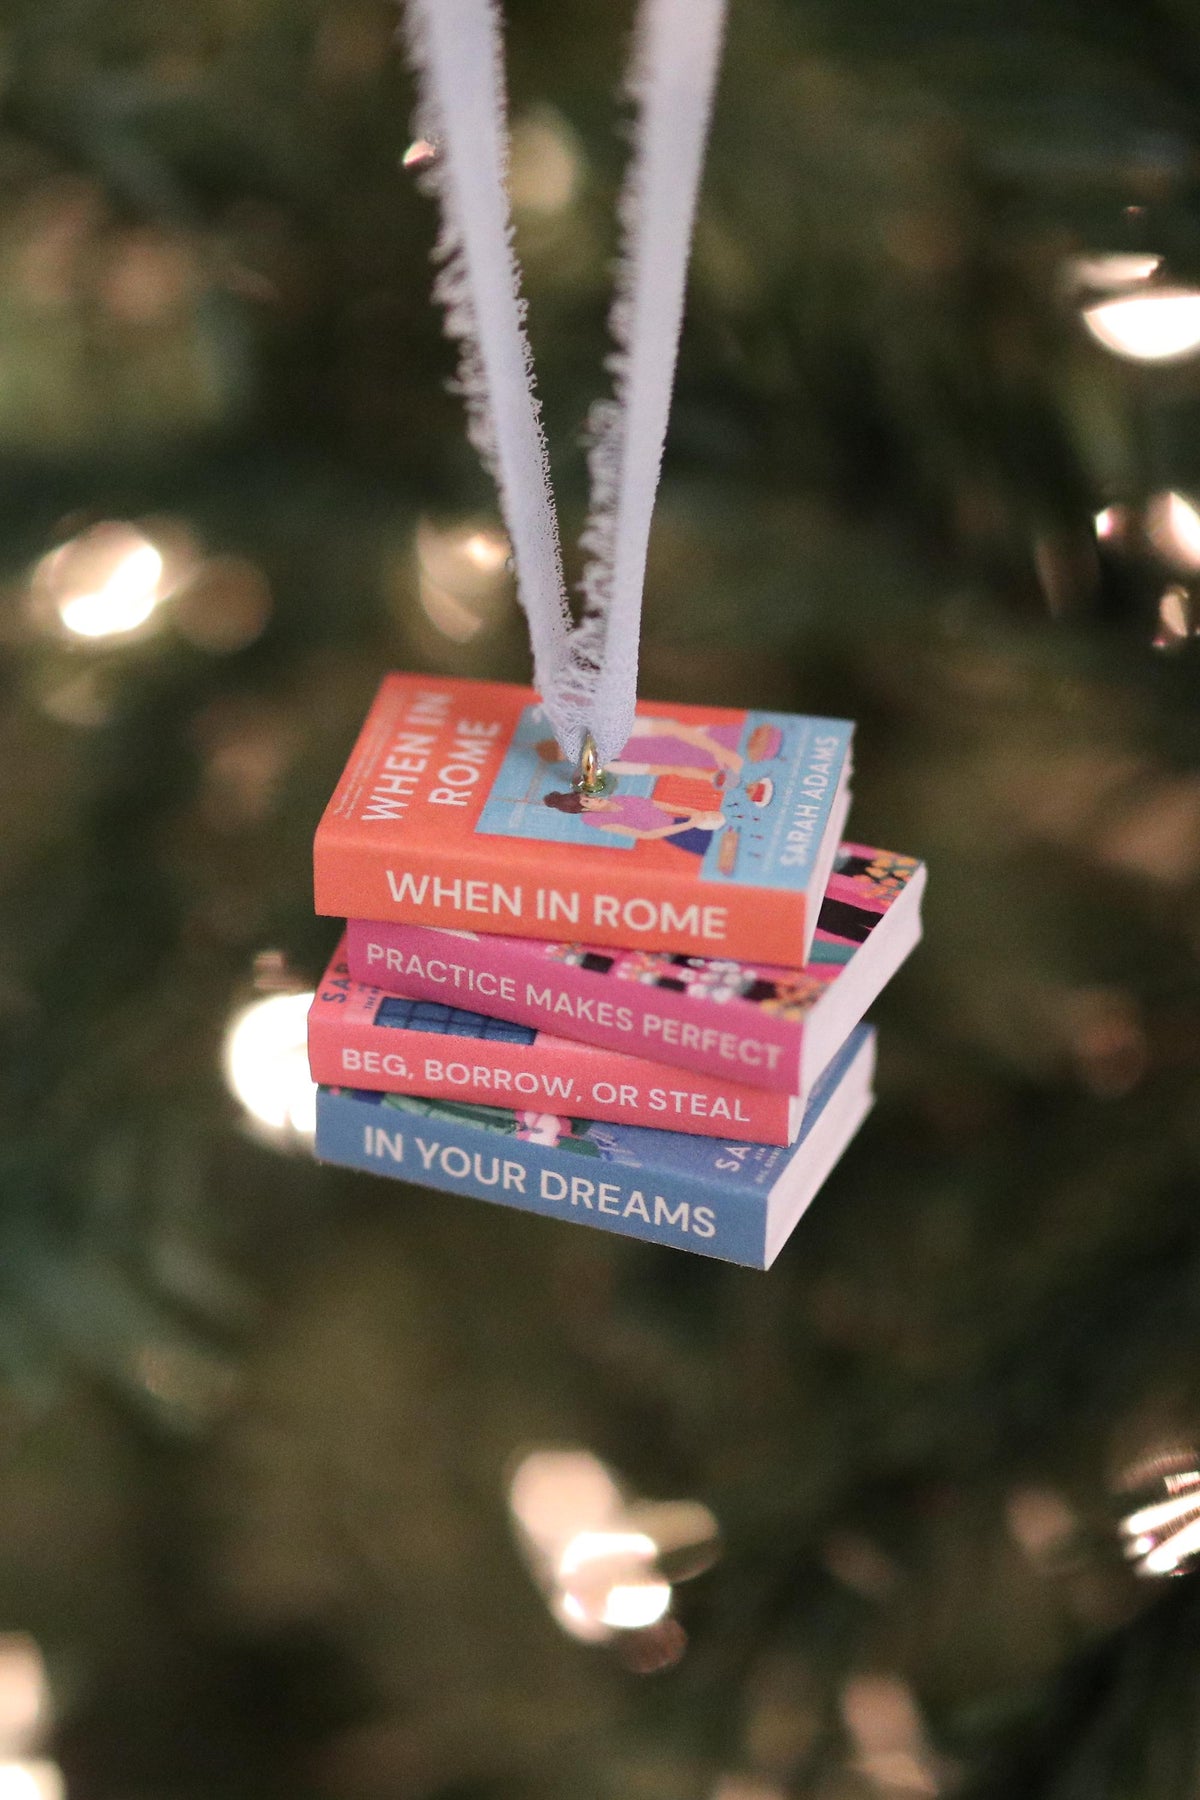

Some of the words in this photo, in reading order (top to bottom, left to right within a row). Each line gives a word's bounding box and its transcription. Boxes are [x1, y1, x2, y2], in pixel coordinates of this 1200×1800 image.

[361, 731, 438, 821] WHEN
[405, 691, 453, 727] IN
[427, 719, 501, 806] ROME
[800, 735, 840, 801] ADAMS
[780, 803, 822, 866] SARAH
[386, 869, 522, 917] WHEN
[537, 888, 579, 924] IN
[593, 894, 729, 940] ROME
[366, 942, 516, 1002] PRACTICE
[526, 983, 634, 1032] MAKES
[642, 1013, 786, 1070] PERFECT
[341, 1048, 415, 1080] BEG,
[424, 1058, 583, 1103] BORROW,
[592, 1082, 639, 1108] OR
[648, 1088, 751, 1123] STEAL
[363, 1125, 404, 1163] IN
[414, 1137, 527, 1195] YOUR
[539, 1168, 717, 1239] DREAMS
